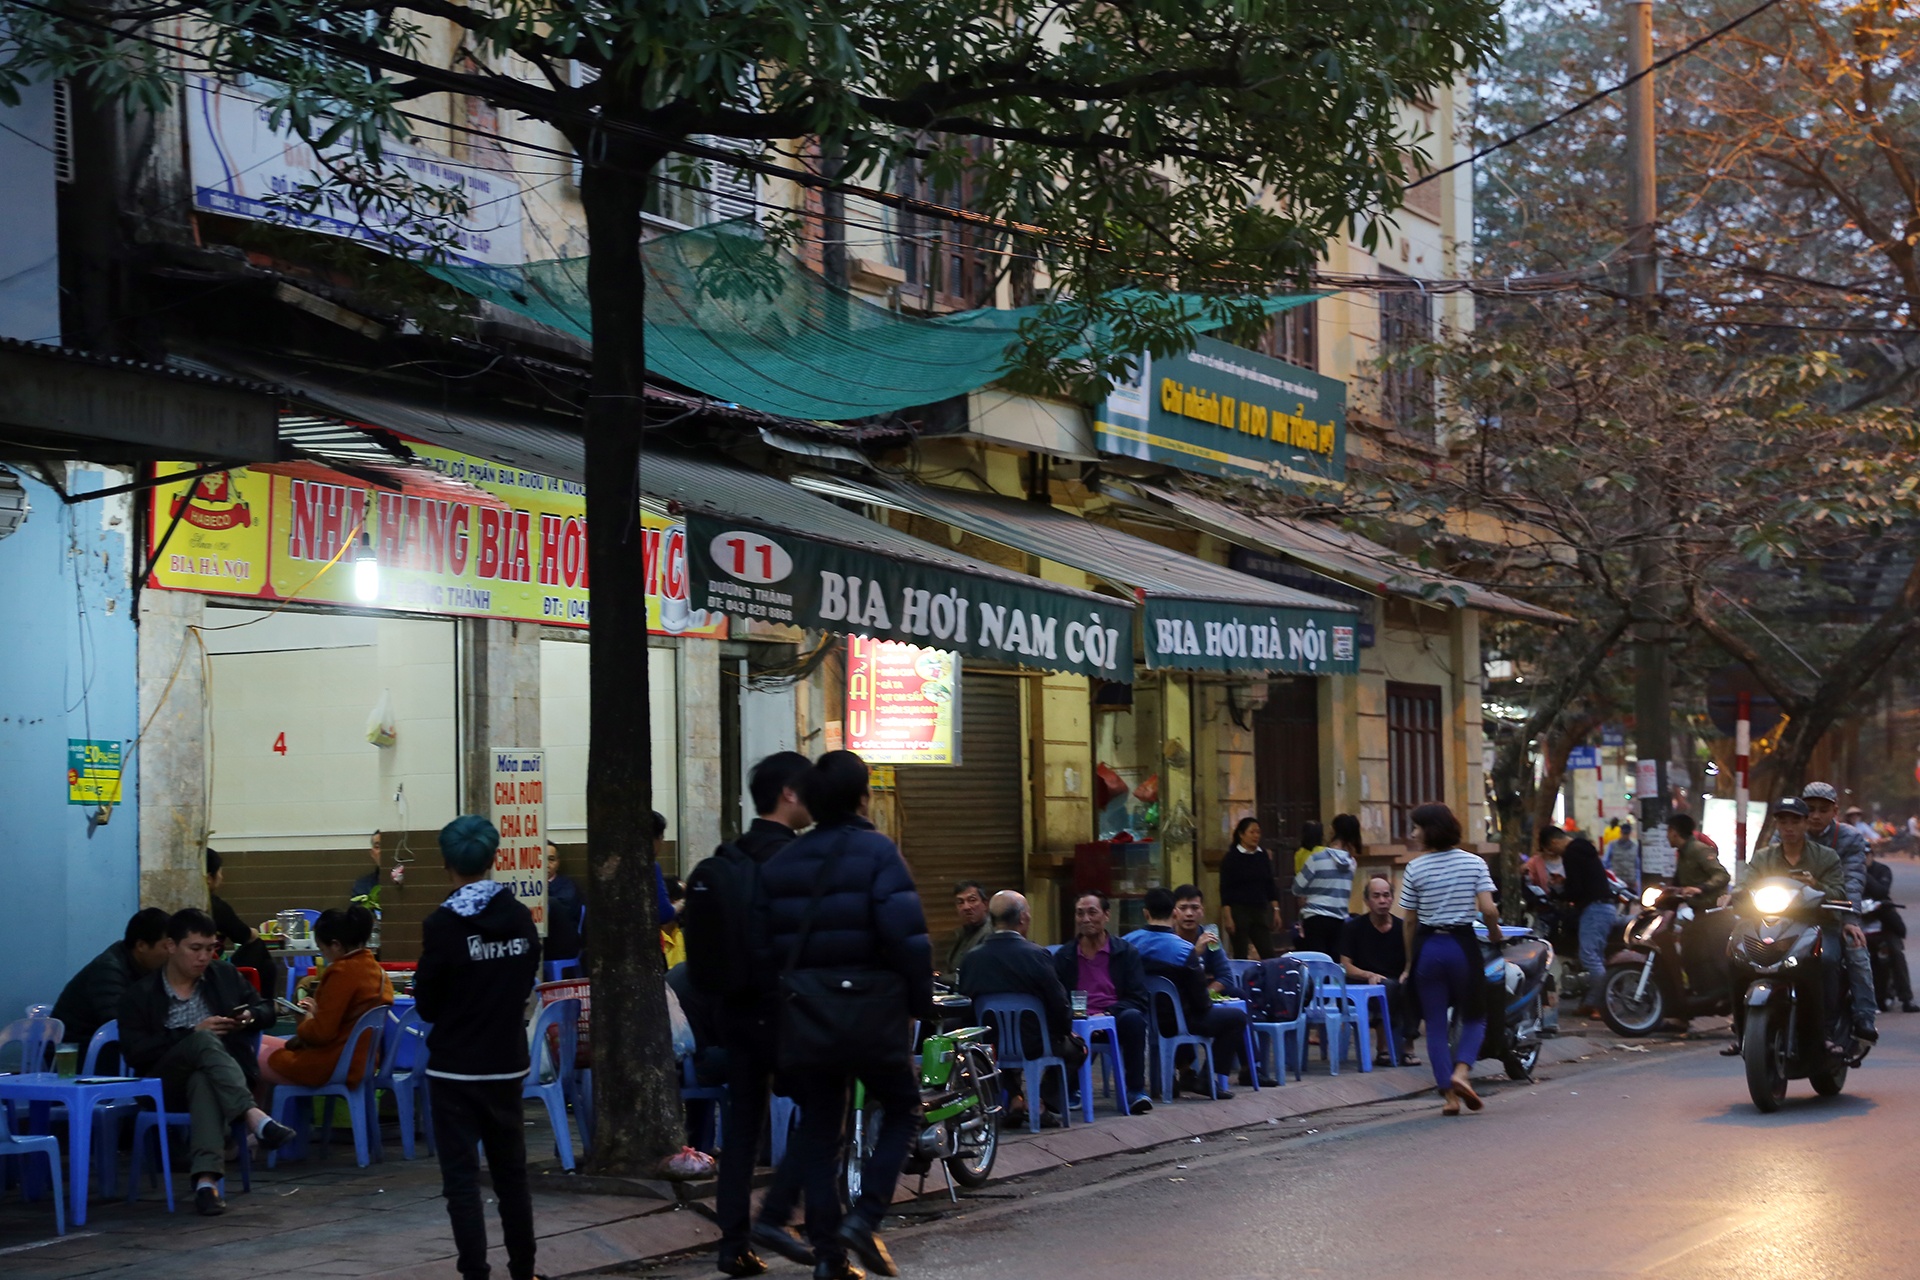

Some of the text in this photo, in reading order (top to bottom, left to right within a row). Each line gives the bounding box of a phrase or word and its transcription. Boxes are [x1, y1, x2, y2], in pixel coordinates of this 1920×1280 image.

[499, 469, 515, 485] BIA
[190, 510, 231, 527] HABECO
[476, 505, 532, 583] BIA
[726, 538, 773, 580] 11
[170, 553, 251, 582] BIA HÀ NỘI
[446, 583, 491, 610] THÀNH
[819, 570, 1119, 670] BIA HƠI NAM CÒI
[1155, 618, 1201, 656] BIA
[1204, 617, 1248, 658] HƠI
[1250, 616, 1285, 660] HÀ
[1288, 618, 1328, 671] NỘI
[272, 731, 288, 756] 4
[496, 754, 541, 772] Món mới
[494, 773, 516, 805] CHẢ
[500, 806, 539, 838] CHẢ CÁ
[495, 839, 542, 874] CHẢ MỰC
[519, 875, 543, 897] XÀO
